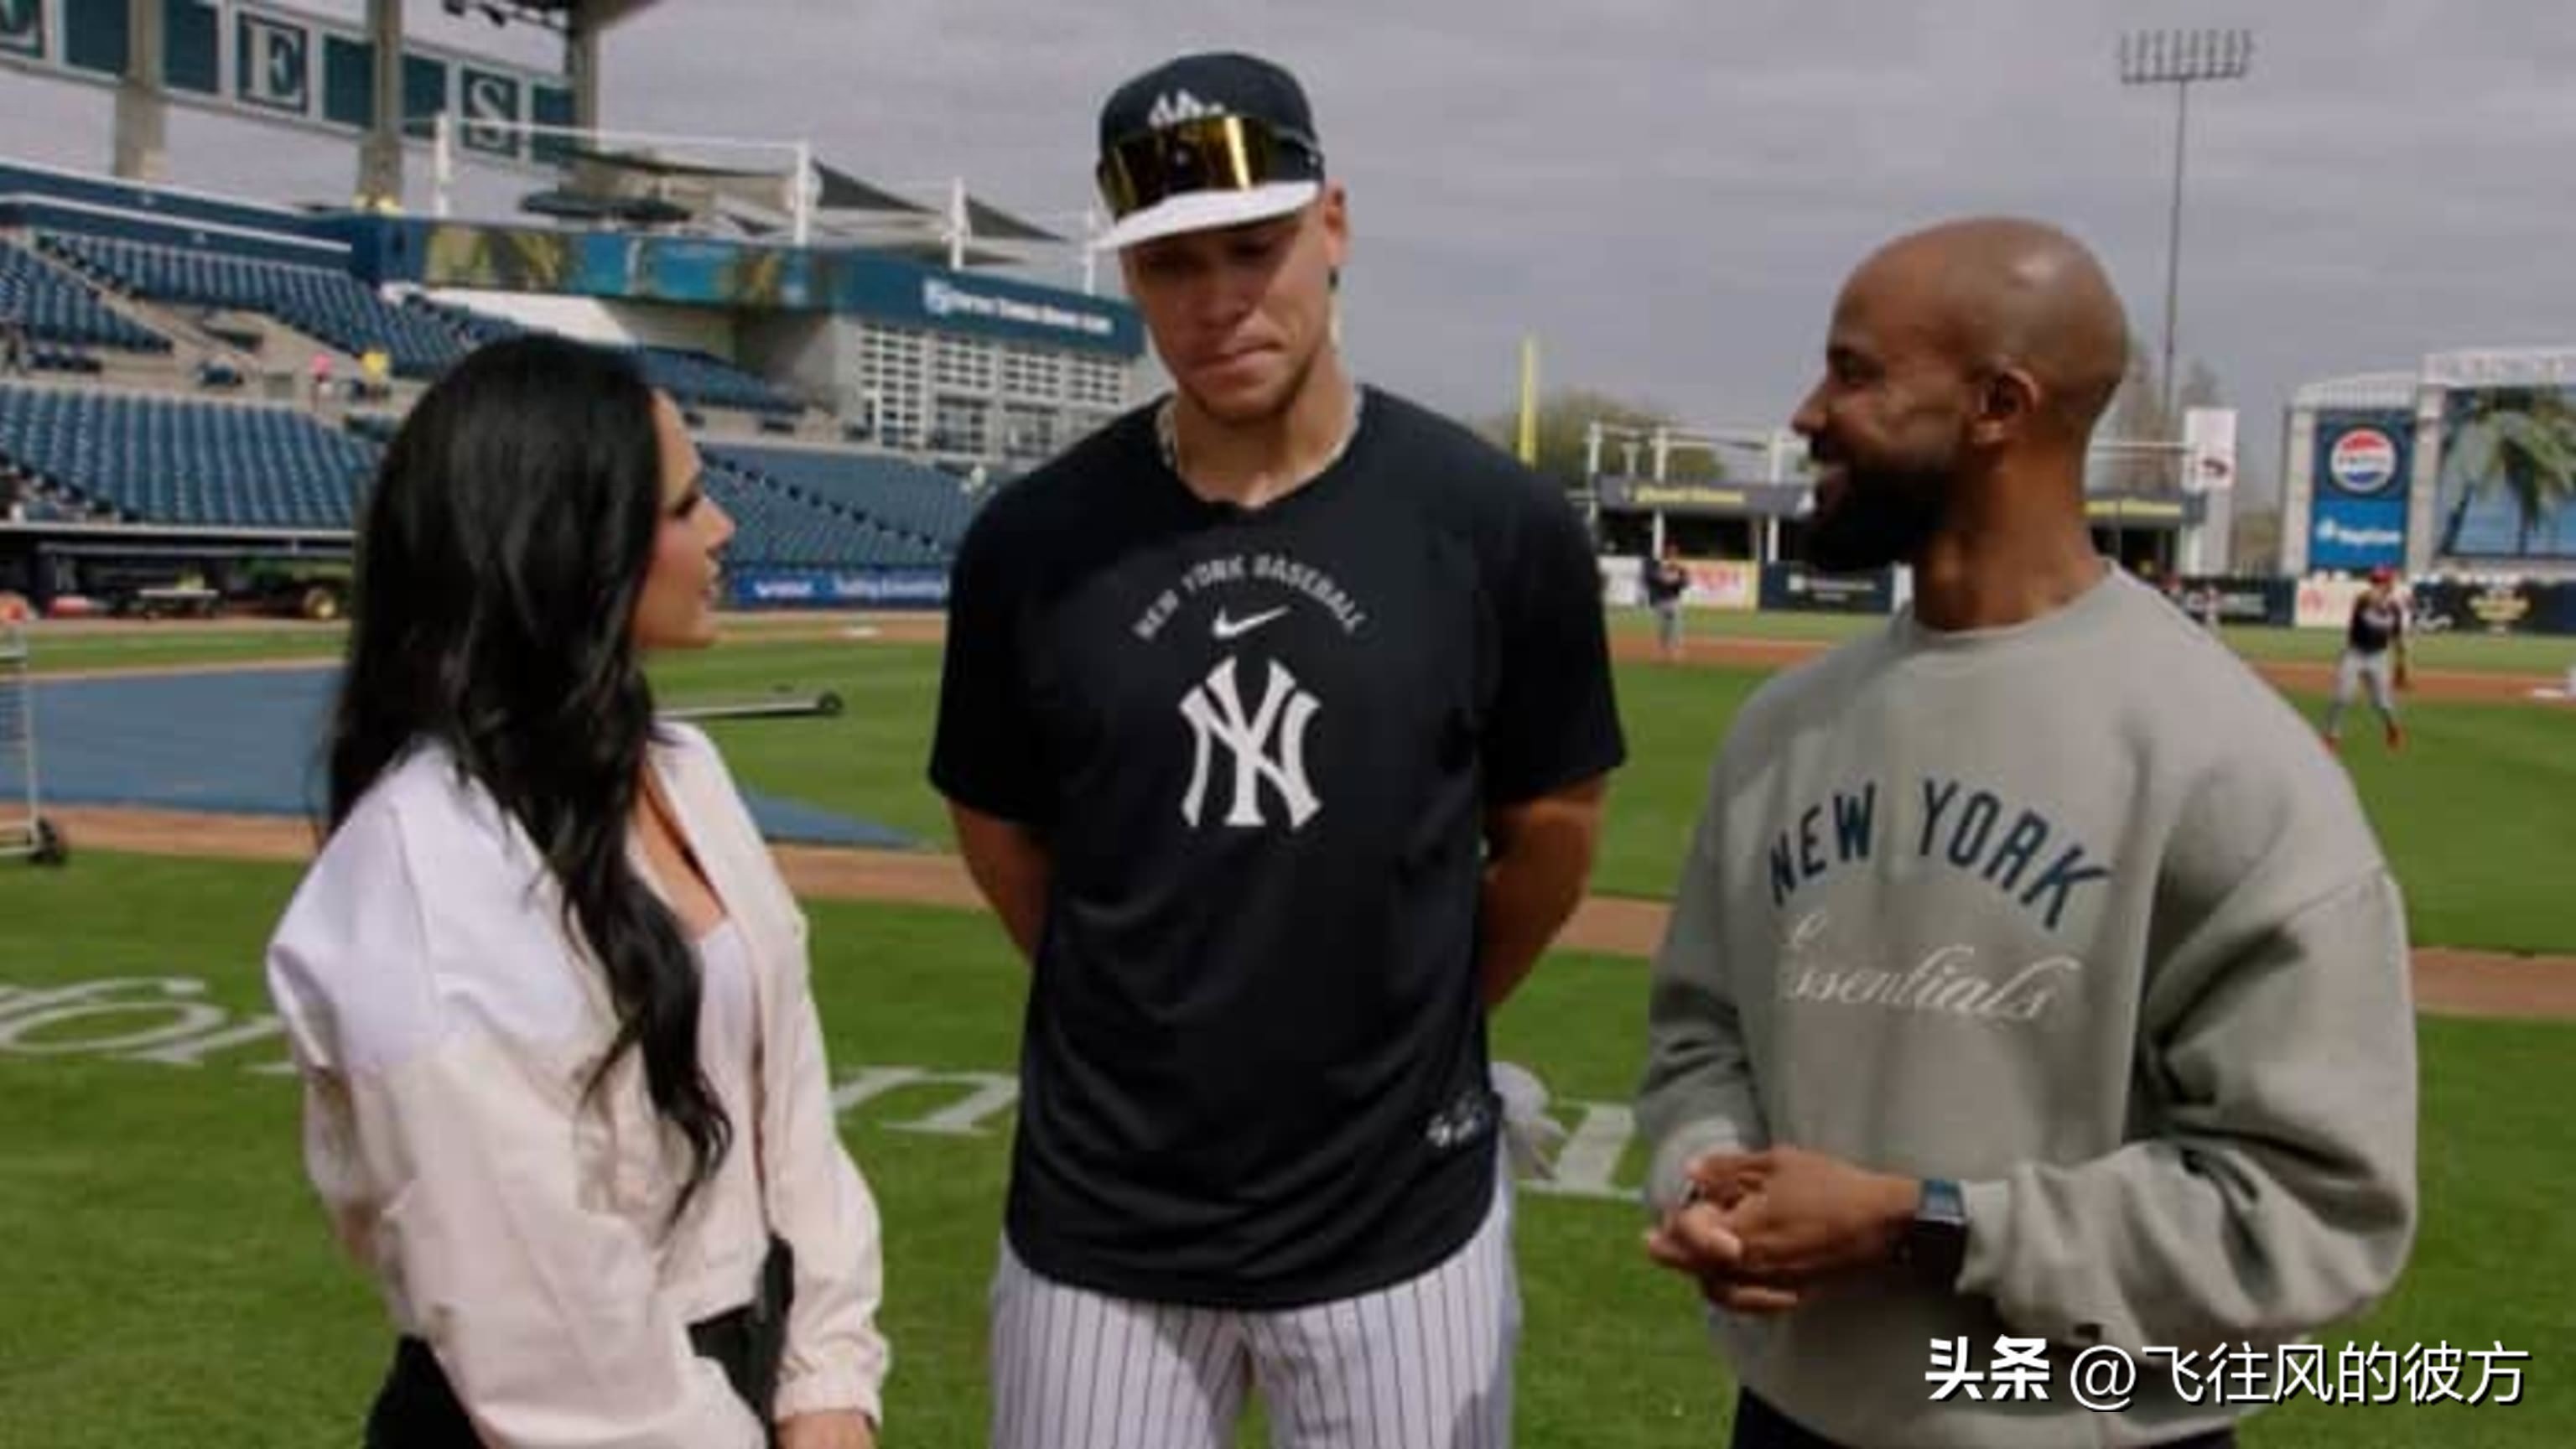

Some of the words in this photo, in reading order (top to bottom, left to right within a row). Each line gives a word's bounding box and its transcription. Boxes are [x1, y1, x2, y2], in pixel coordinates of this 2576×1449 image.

[1181, 553, 1245, 591] YORK
[1254, 553, 1367, 634] BASEBALL
[1177, 655, 1322, 828] NY
[1770, 783, 1875, 907] NEW
[1919, 779, 2109, 929] YORK
